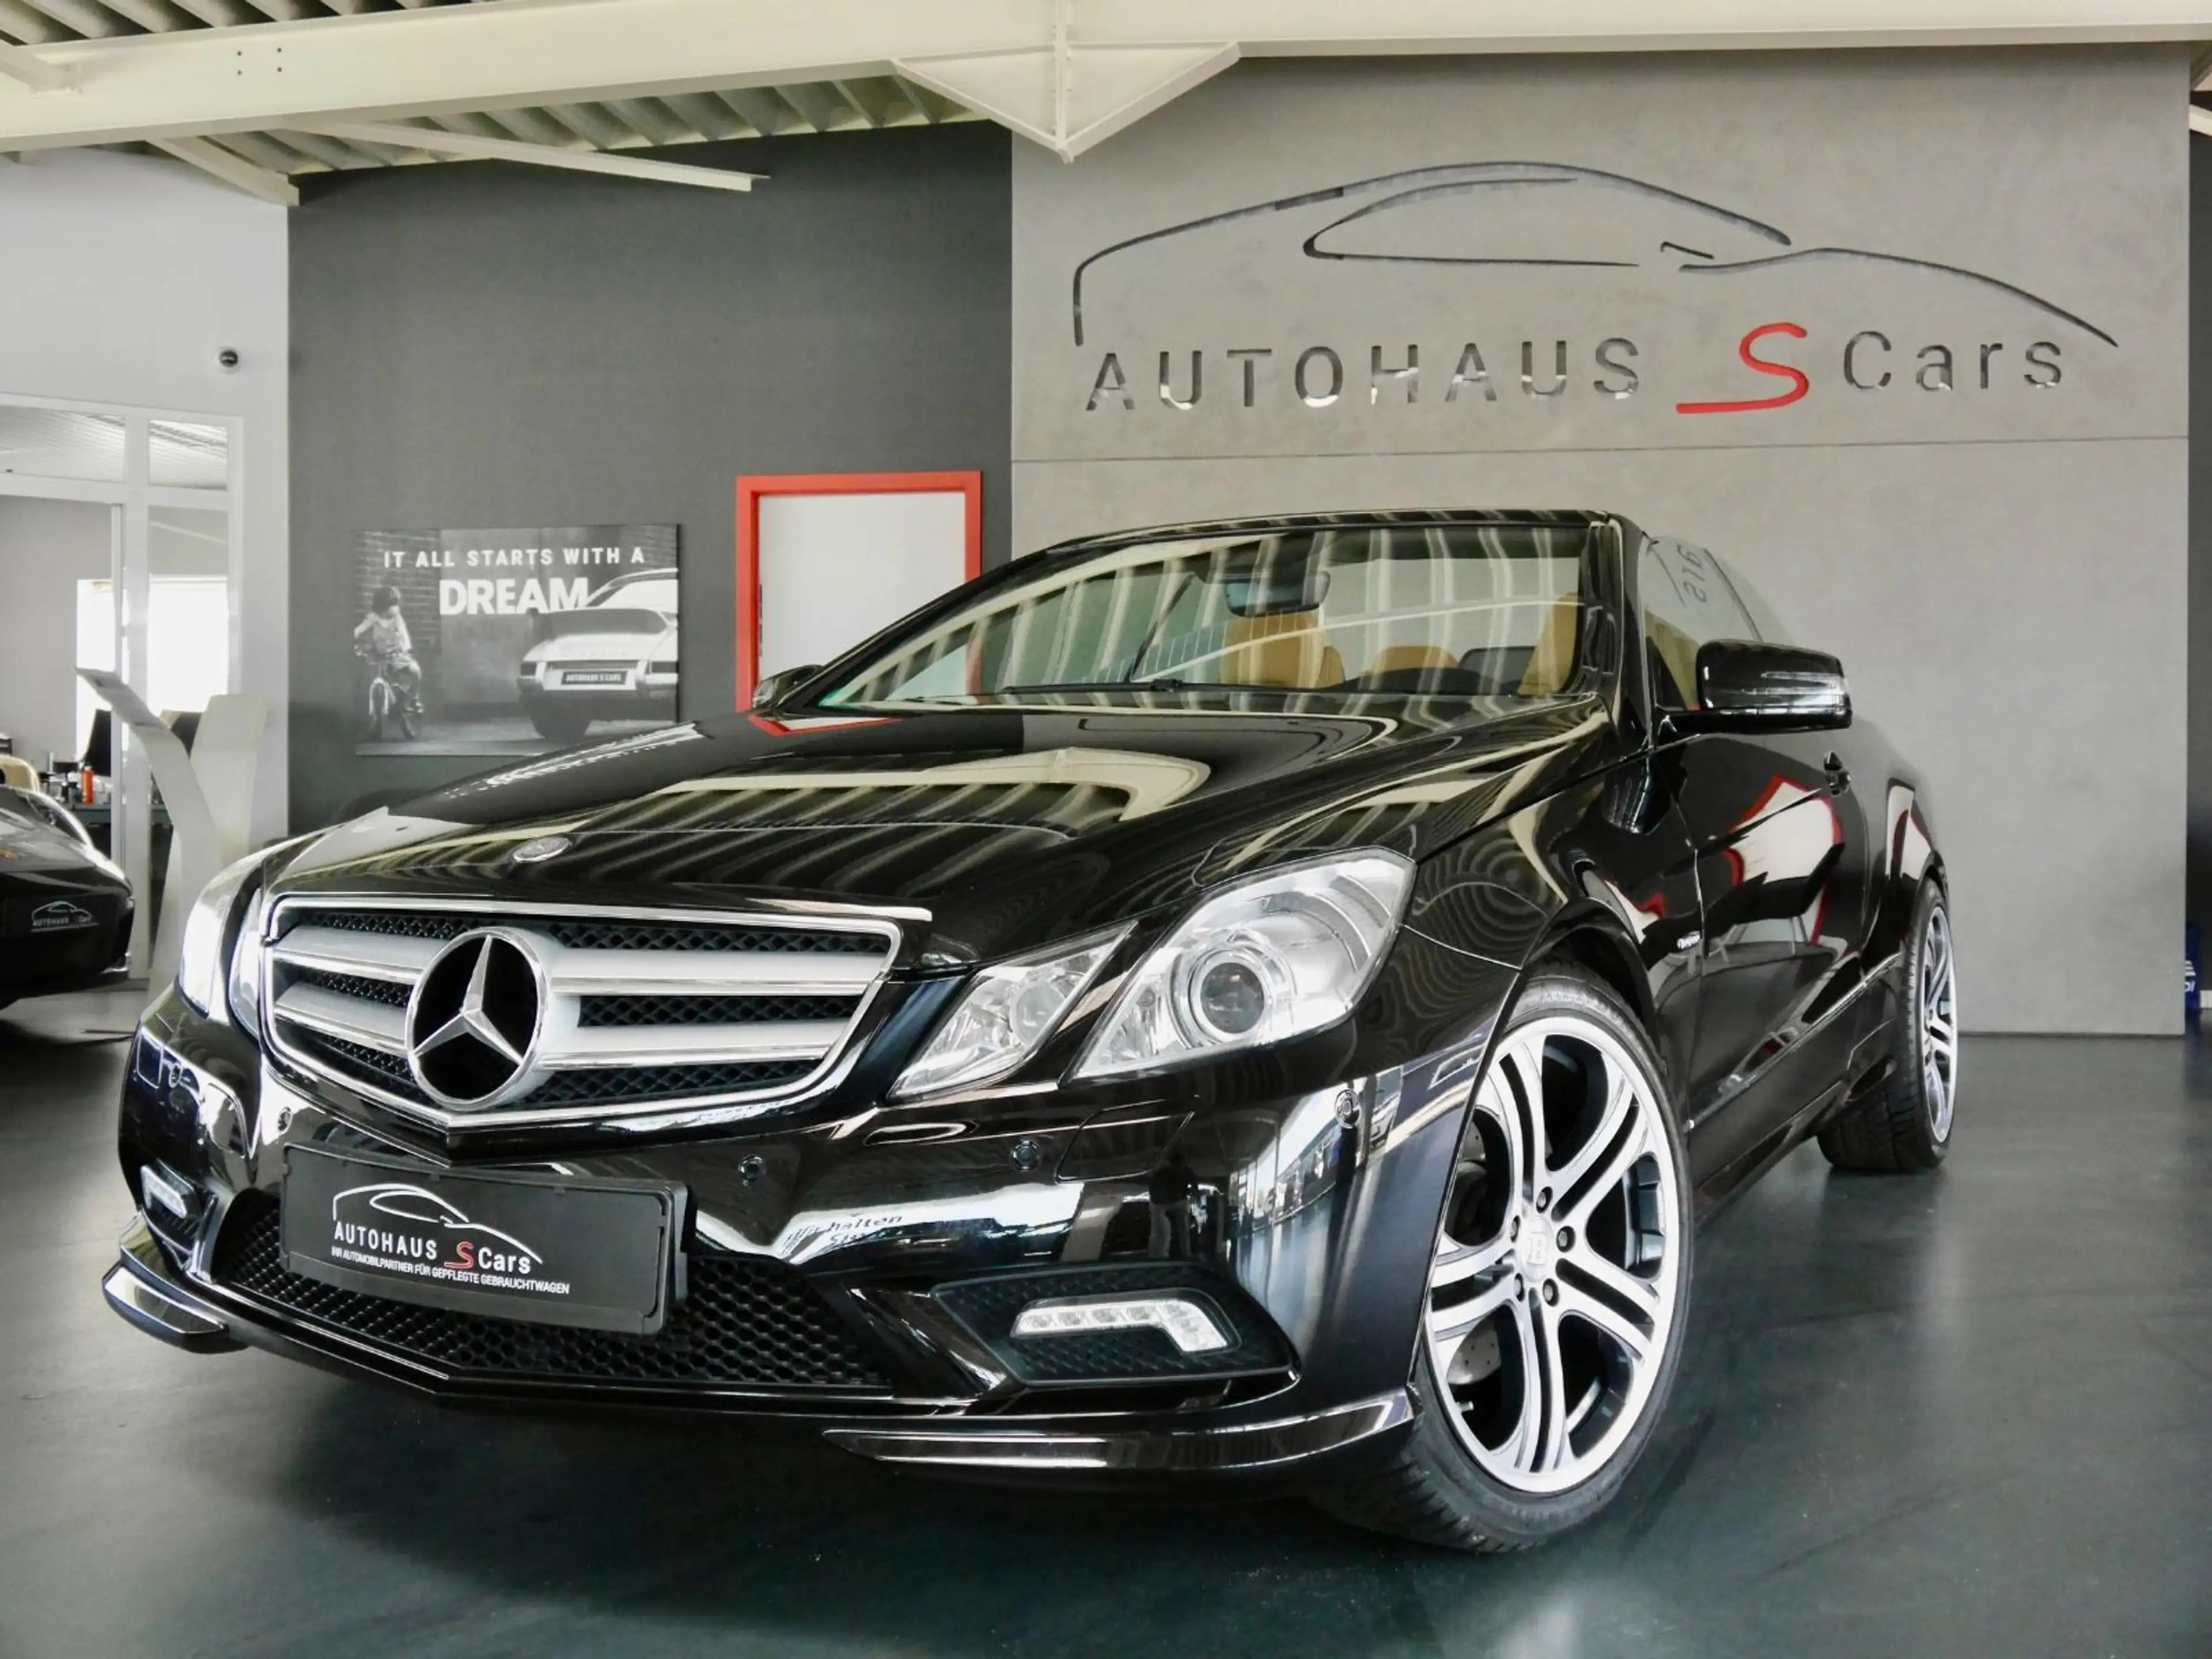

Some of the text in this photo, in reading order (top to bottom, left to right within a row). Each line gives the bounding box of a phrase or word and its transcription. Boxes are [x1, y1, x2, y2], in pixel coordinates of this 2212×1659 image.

[1085, 321, 2062, 414] AUTOHAUS S Cars
[384, 546, 645, 568] IT ALL STARTS WITH A
[440, 577, 589, 615] DREAM
[334, 1220, 532, 1274] AUTOHAUS S Cars
[415, 1263, 431, 1277] FÜR
[480, 1274, 570, 1294] GEBRAUCHTWAGEN
